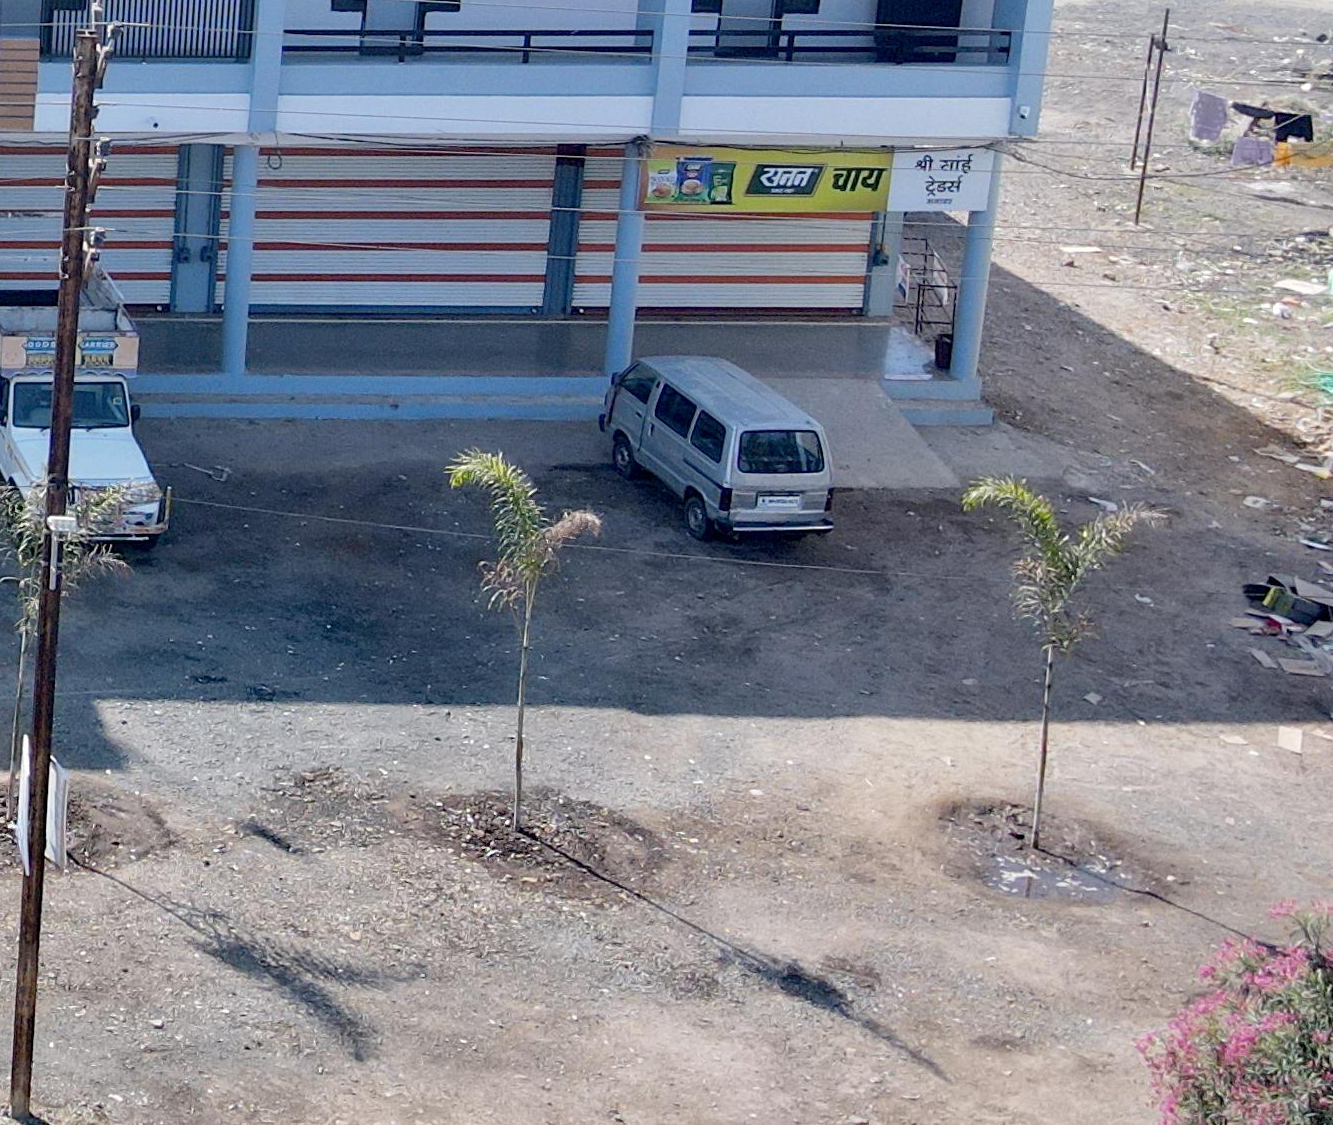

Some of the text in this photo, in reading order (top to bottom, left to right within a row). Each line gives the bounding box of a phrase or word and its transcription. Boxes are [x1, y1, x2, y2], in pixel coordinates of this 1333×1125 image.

[915, 154, 933, 172] श्री
[832, 168, 887, 191] चाय
[925, 175, 963, 196] ट्रेडर्स
